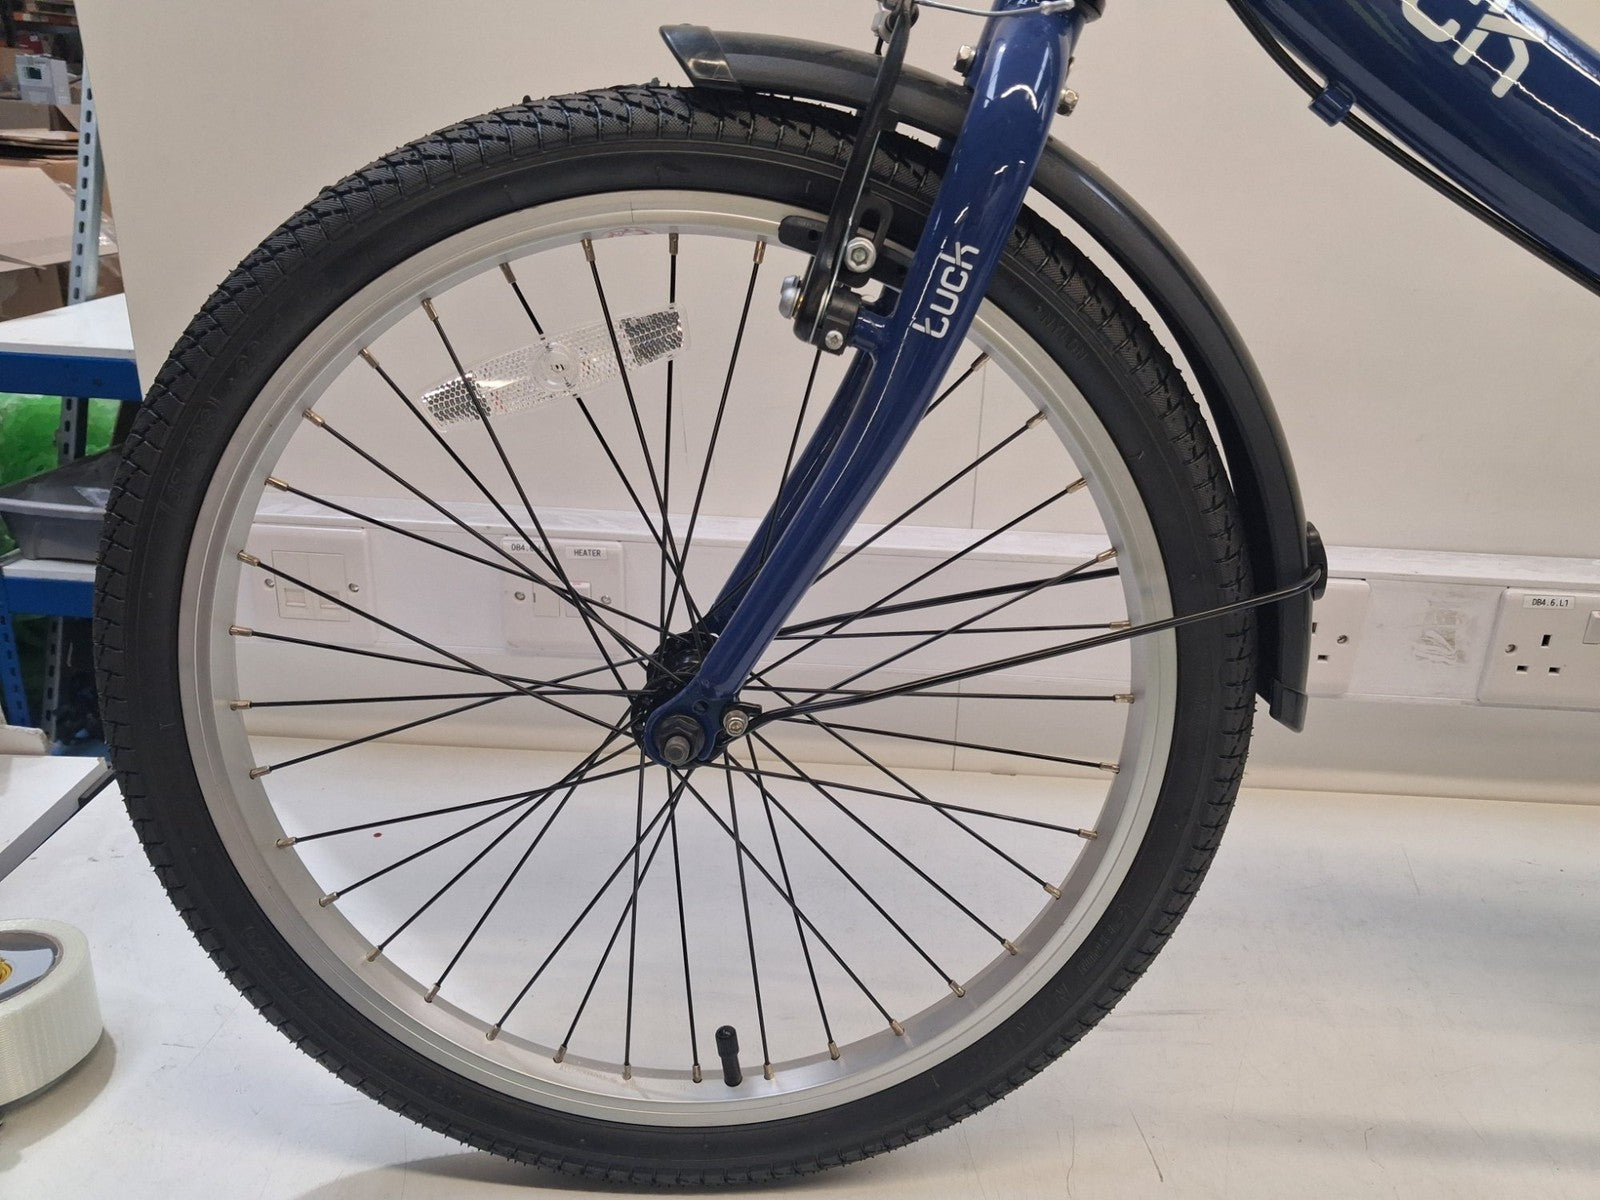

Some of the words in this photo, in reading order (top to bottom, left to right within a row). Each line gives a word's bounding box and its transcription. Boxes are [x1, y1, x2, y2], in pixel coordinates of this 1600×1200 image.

[912, 241, 980, 339] tuck
[573, 549, 602, 557] HEATER
[1532, 598, 1569, 607] DB4.6.L1
